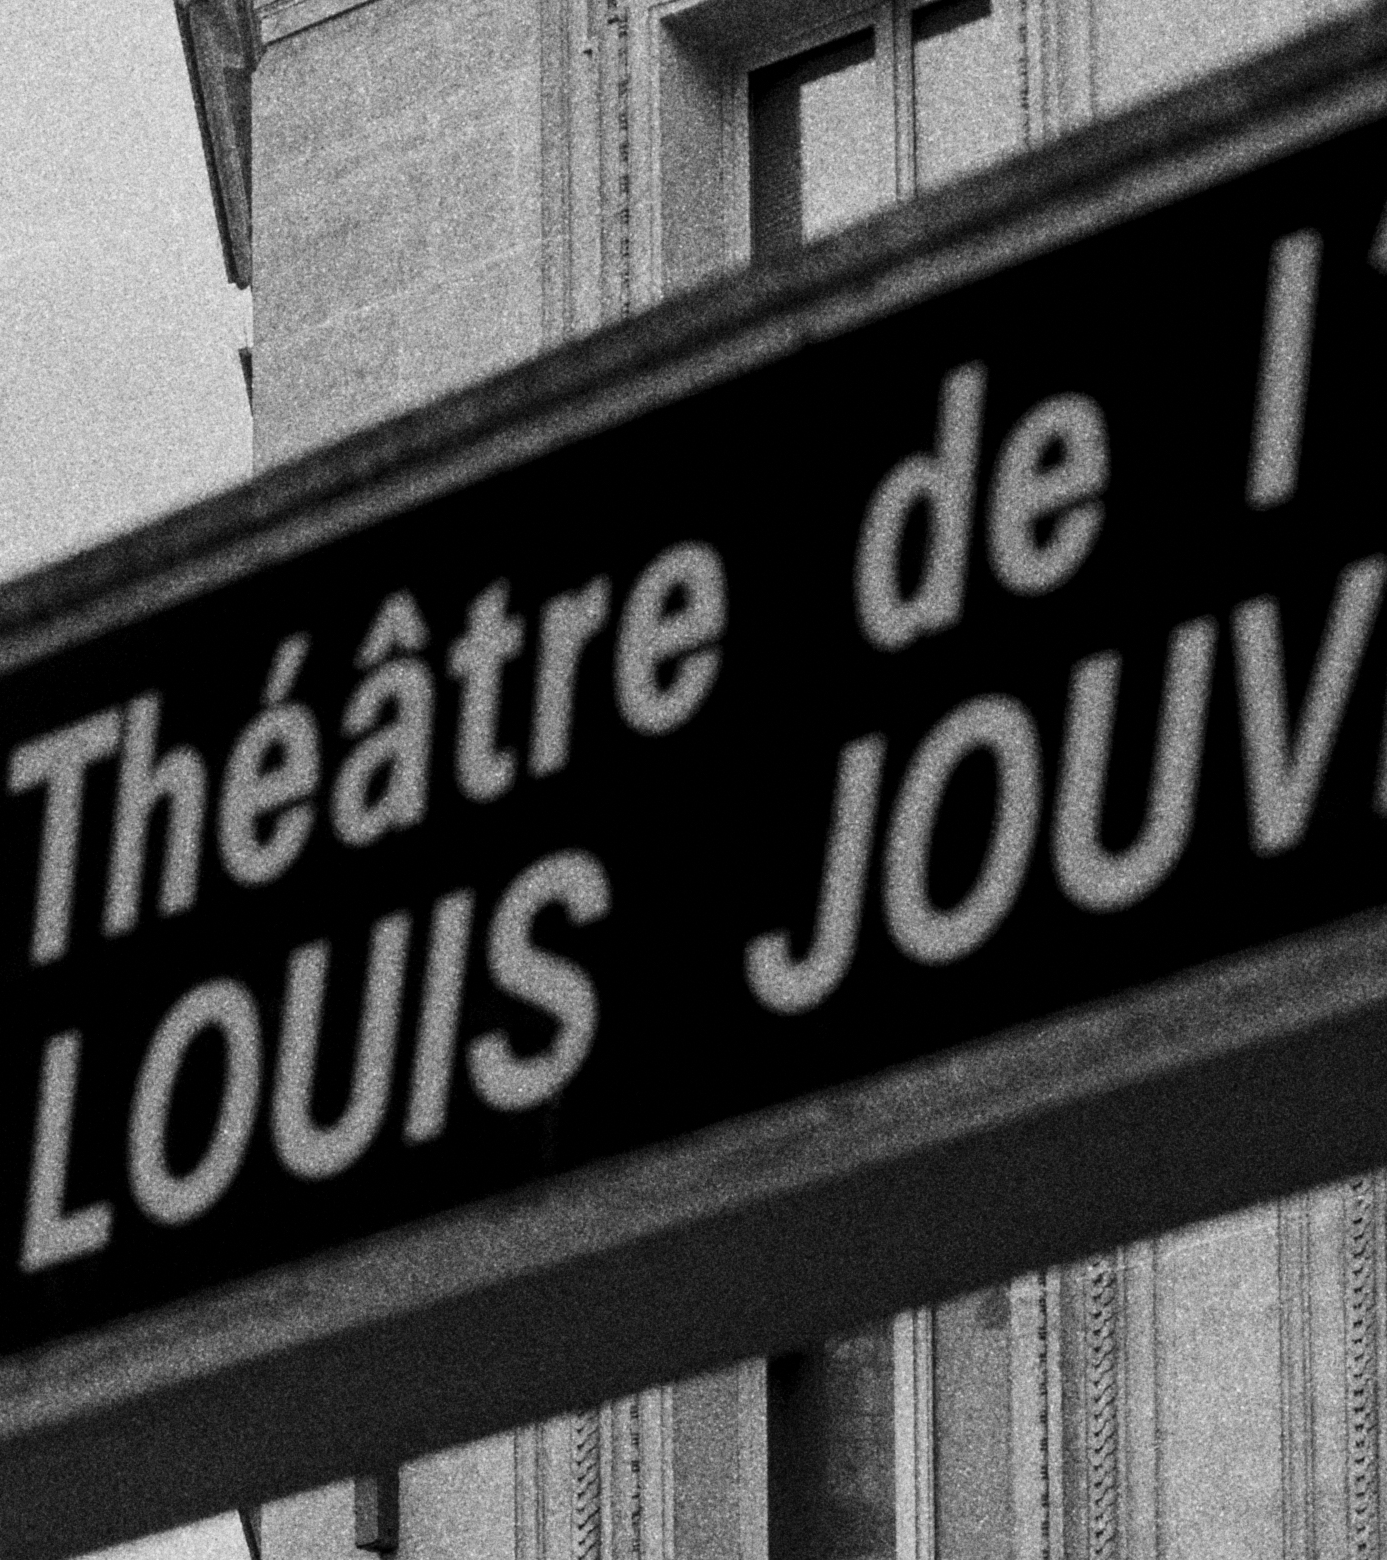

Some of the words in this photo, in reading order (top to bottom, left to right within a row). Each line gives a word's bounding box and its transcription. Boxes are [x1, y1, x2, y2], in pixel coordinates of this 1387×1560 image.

[9, 546, 727, 963] Théâtre
[857, 366, 1108, 649] de
[21, 852, 610, 1270] LOUIS
[746, 556, 1387, 1012] JOUV
